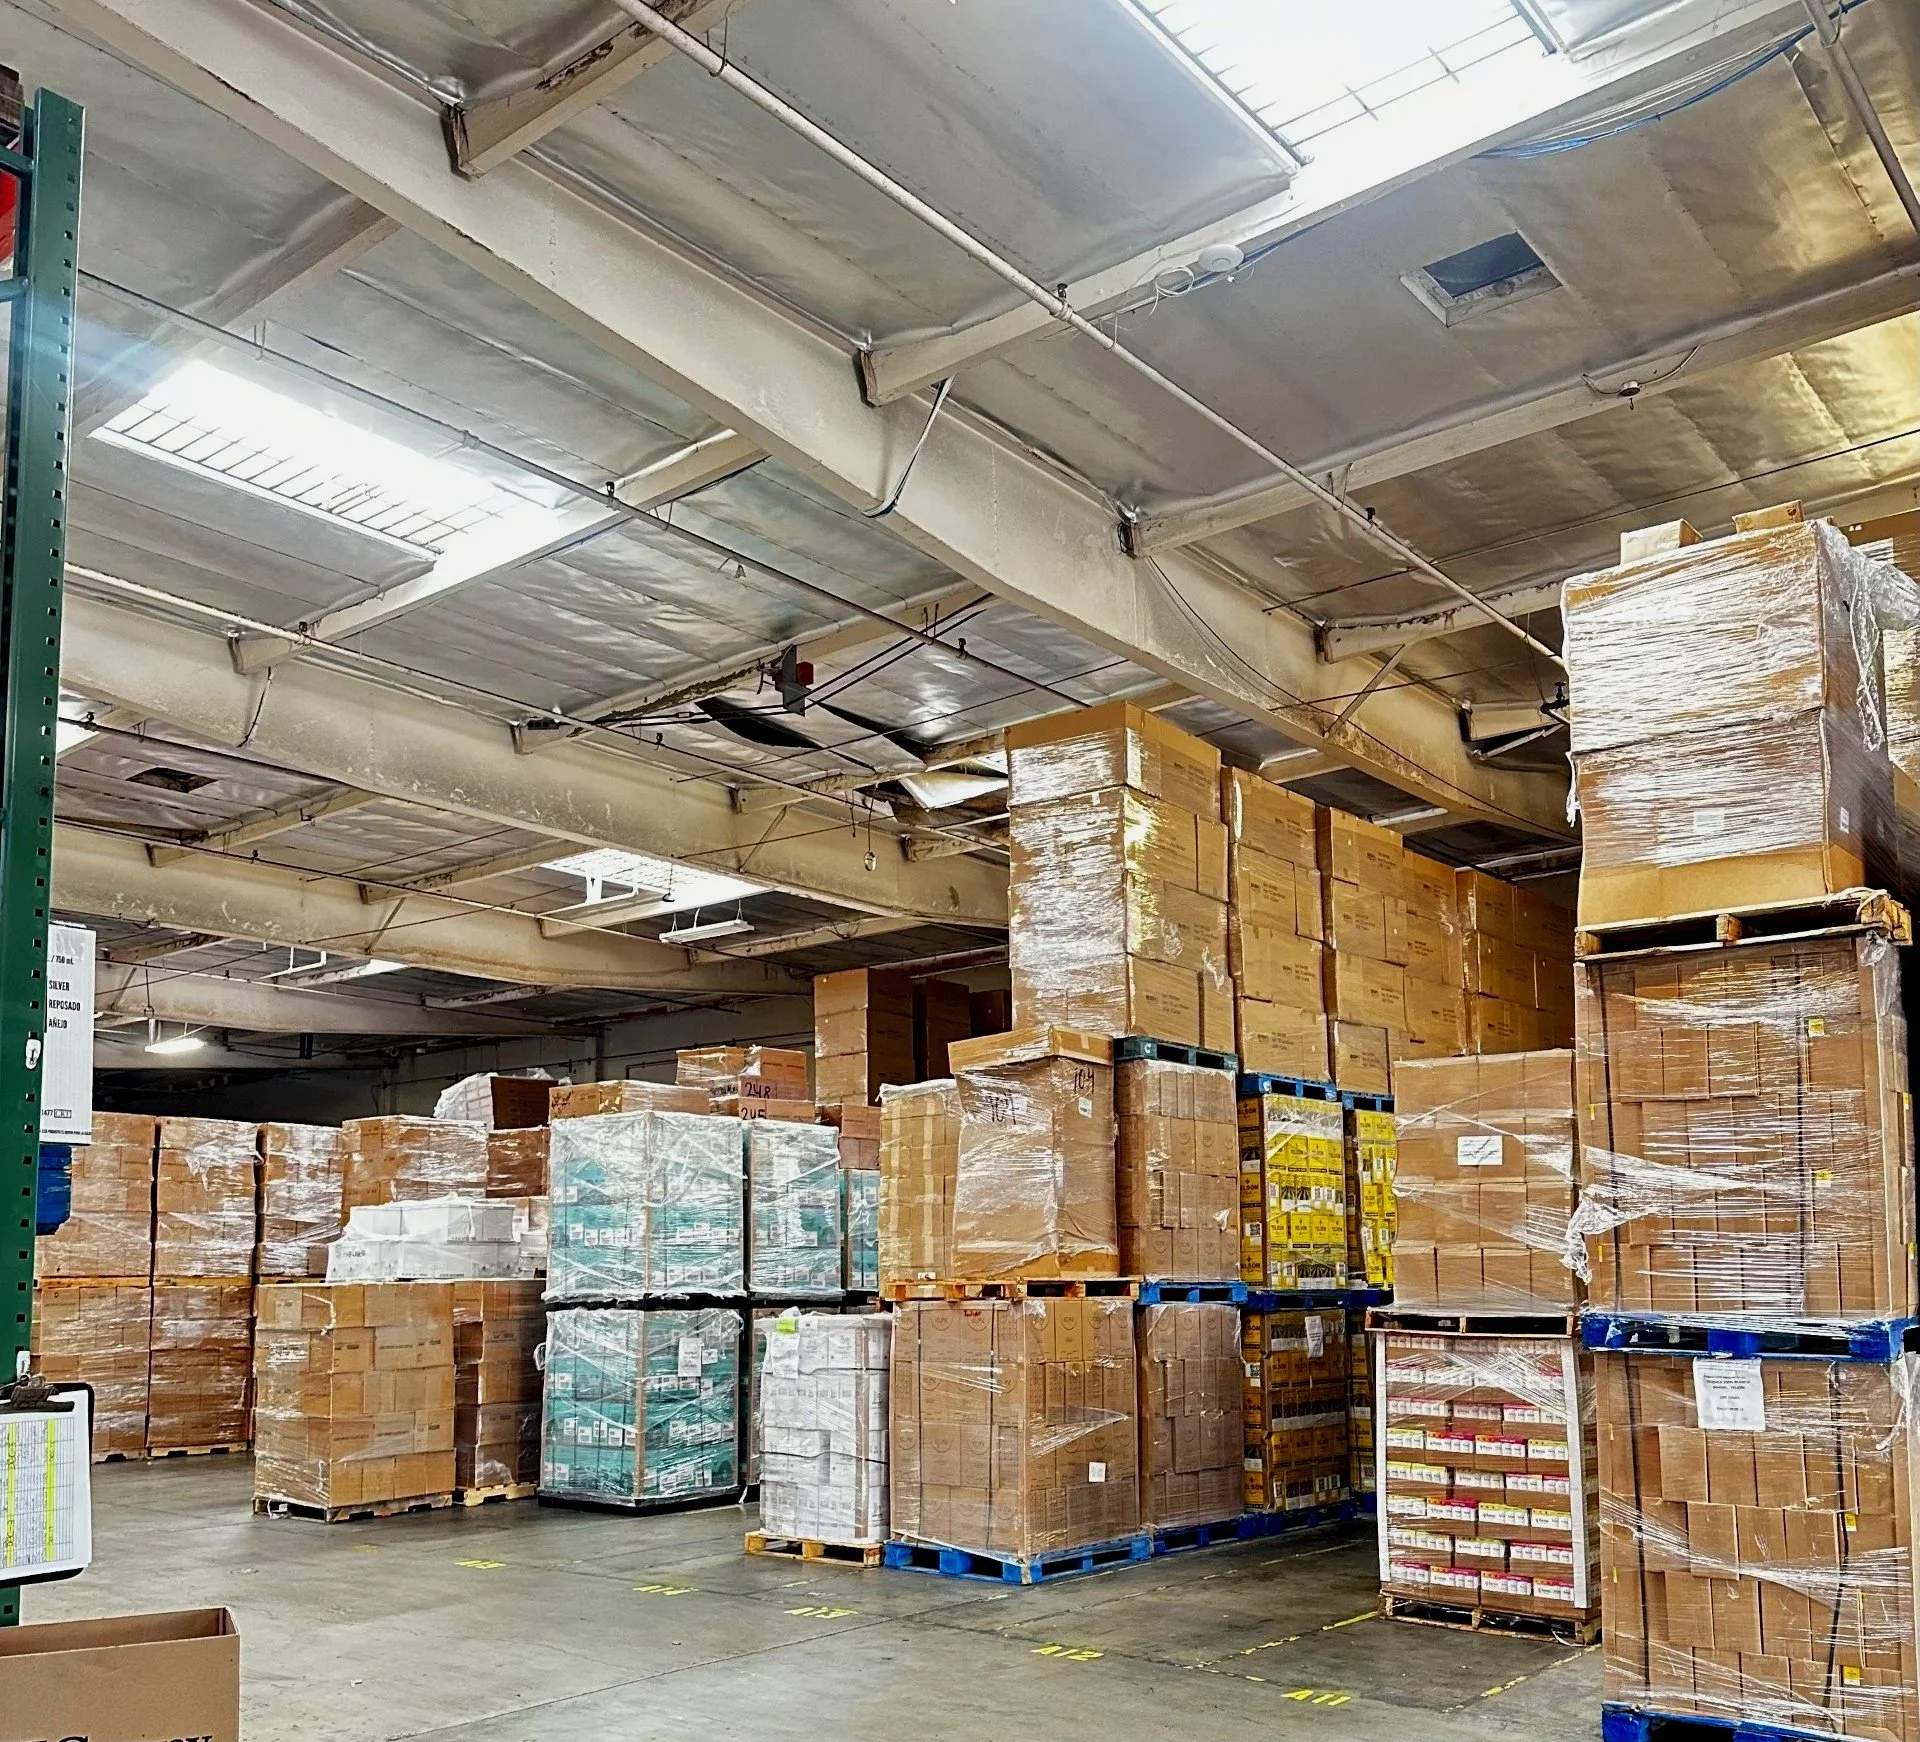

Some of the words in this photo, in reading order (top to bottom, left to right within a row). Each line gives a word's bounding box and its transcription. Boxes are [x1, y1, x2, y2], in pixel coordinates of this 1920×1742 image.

[56, 955, 65, 964] 750
[48, 980, 70, 991] SILVER
[48, 999, 81, 1012] REPOSADO
[48, 1017, 67, 1029] AÑEJO
[1073, 1067, 1095, 1094] 104
[744, 1081, 771, 1099] 248
[1030, 1644, 1104, 1661] A12
[1280, 1689, 1351, 1706] A11
